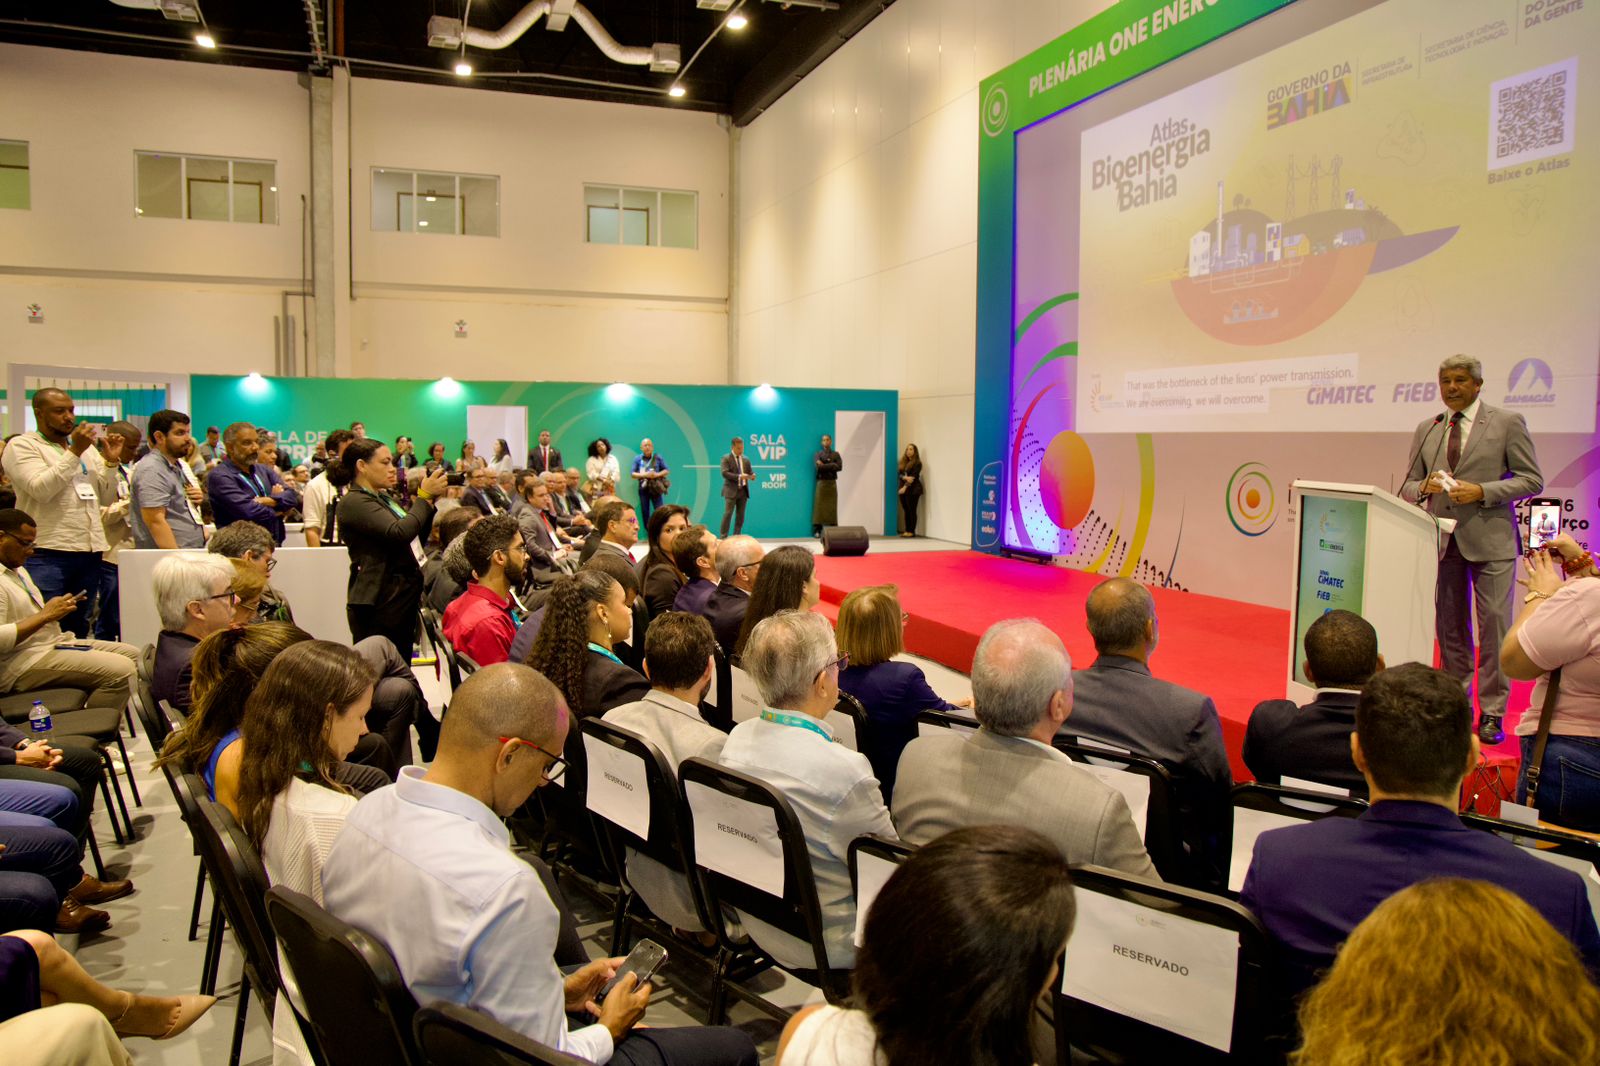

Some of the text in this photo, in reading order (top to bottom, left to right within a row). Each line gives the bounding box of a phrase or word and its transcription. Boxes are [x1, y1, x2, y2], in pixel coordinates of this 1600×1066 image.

[1524, 0, 1584, 29] DA GENTE
[1029, 42, 1106, 98] PLENÁRIA
[1109, 16, 1148, 57] ONE
[1267, 61, 1351, 103] GOVERNO DA
[1267, 76, 1351, 130] BAHIA
[1149, 117, 1188, 147] Atlas
[1092, 123, 1211, 191] Bioenergia
[1488, 158, 1570, 185] Baixe o Atlas
[1118, 168, 1178, 212] Bahia
[1169, 376, 1208, 388] bottleneck
[1220, 373, 1234, 385] the
[1260, 372, 1288, 384] power
[750, 434, 786, 446] SALA
[758, 446, 787, 460] VIP
[761, 481, 786, 489] ROOM
[769, 473, 786, 481] VIP
[603, 771, 634, 792] RESERVADO
[717, 822, 759, 844] RESERVADO
[1113, 944, 1189, 977] RESERVADO
